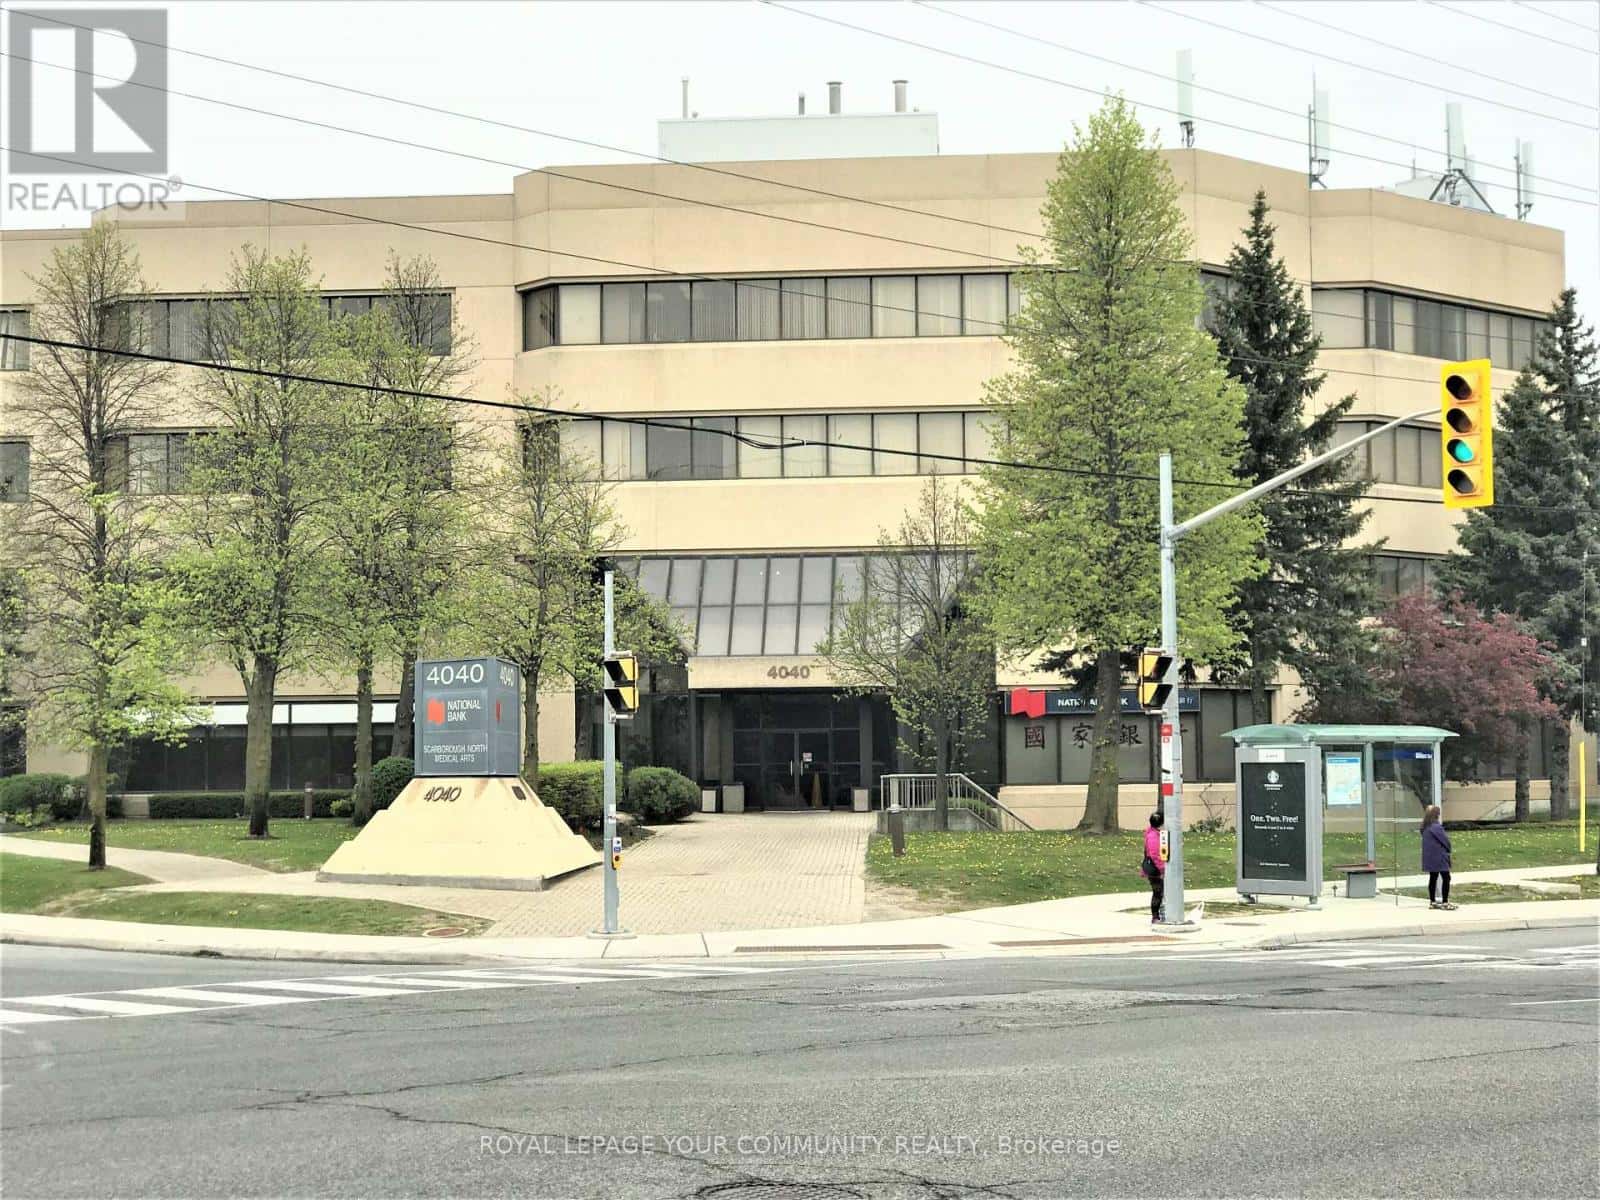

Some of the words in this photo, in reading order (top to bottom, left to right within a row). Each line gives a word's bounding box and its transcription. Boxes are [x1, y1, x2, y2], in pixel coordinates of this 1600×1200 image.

[426, 663, 484, 685] 4040
[500, 665, 514, 687] 4040
[766, 665, 810, 679] 4040
[447, 699, 481, 710] NATIONAL
[447, 711, 467, 721] BANK
[424, 744, 465, 753] SCARBOROUGH
[467, 743, 488, 753] NORTH
[434, 754, 459, 763] MEDICAL
[460, 753, 475, 762] ARTS
[424, 786, 462, 802] 4040
